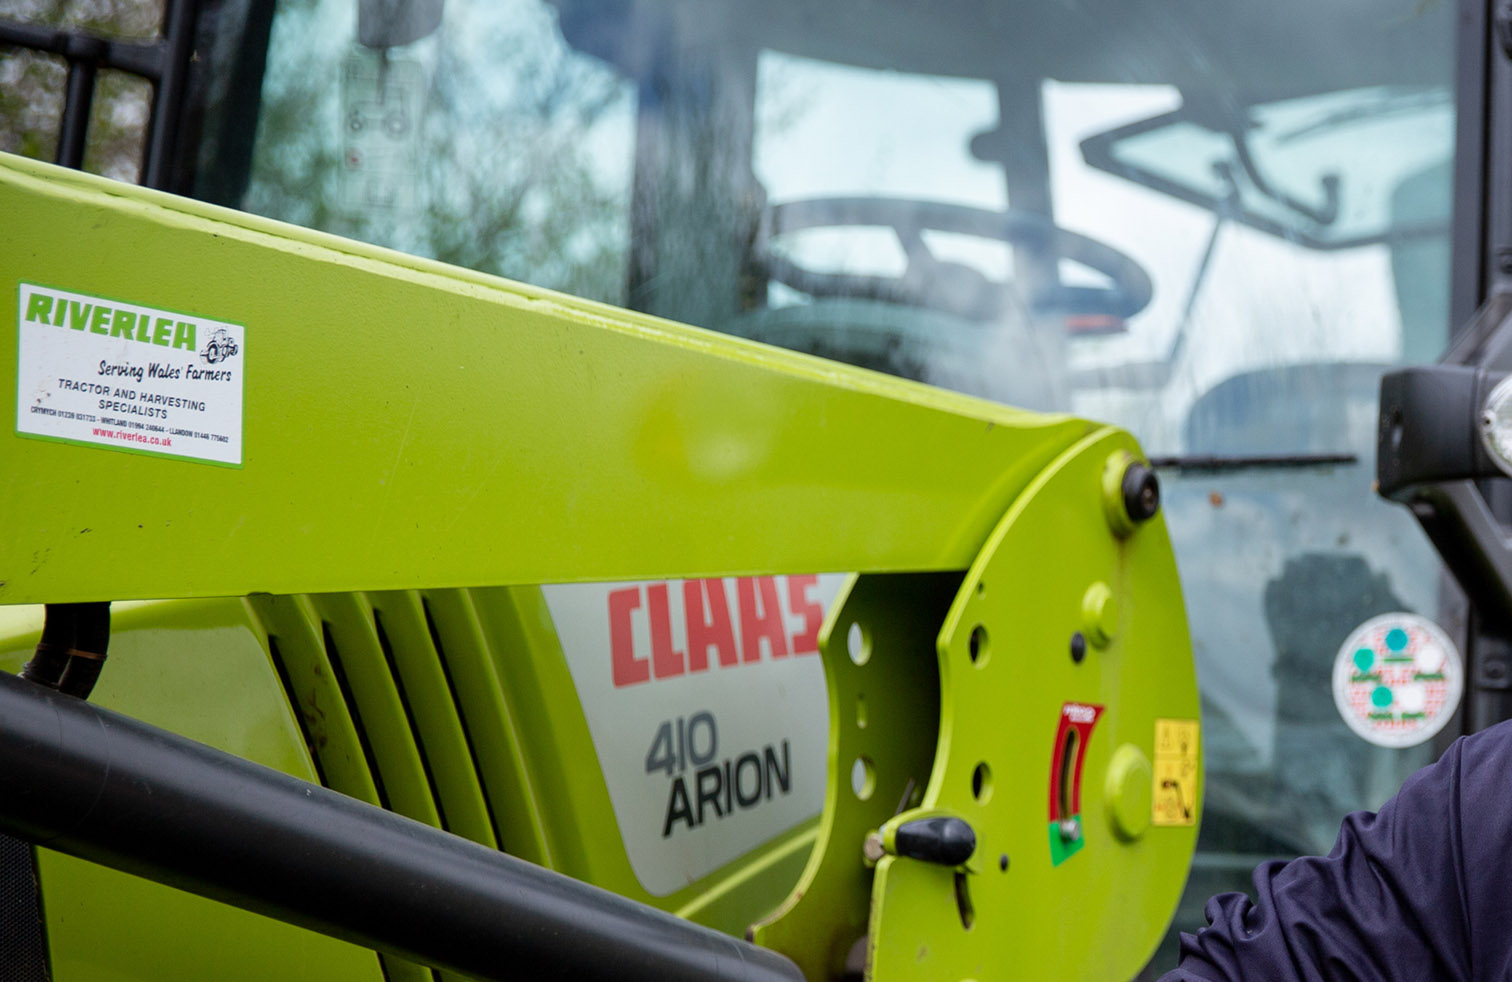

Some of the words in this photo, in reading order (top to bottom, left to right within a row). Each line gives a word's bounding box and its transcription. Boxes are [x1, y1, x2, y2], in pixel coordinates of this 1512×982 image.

[25, 292, 197, 352] RIVERLEA
[98, 360, 144, 382] Serving
[186, 364, 231, 381] Farmers
[58, 378, 110, 396] TRACTOR
[113, 388, 136, 400] AND
[140, 392, 206, 412] HARVESTING
[98, 400, 168, 419] SPECIALISTS
[93, 427, 172, 447] www.riverlea.co.uk
[608, 574, 825, 689] CLAAS
[646, 709, 717, 776] 410
[661, 737, 792, 840] ARION
